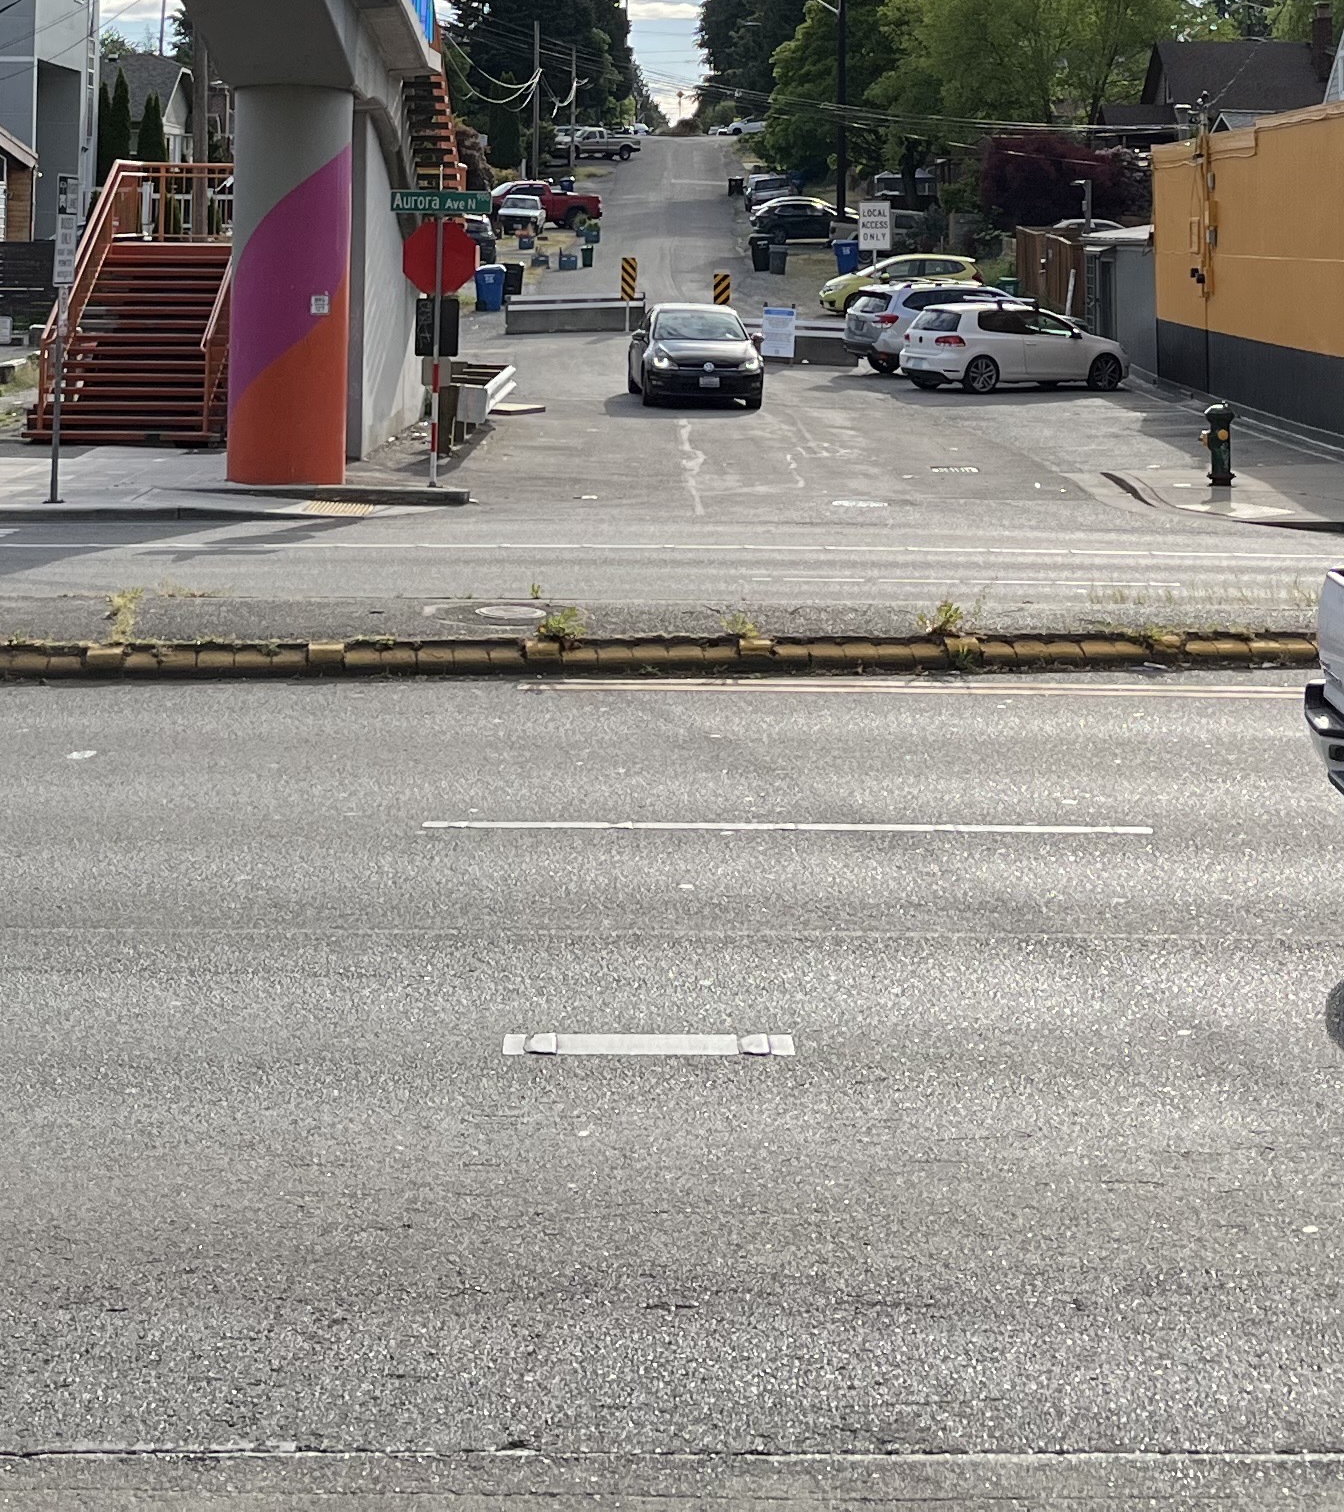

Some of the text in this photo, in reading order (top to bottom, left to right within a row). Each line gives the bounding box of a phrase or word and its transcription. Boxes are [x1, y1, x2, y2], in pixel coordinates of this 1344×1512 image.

[393, 192, 440, 209] Aurora
[444, 198, 466, 210] Ave
[467, 198, 476, 210] N
[862, 208, 887, 218] LOCAL
[861, 220, 889, 230] ACCESS
[862, 232, 887, 241] ONLY
